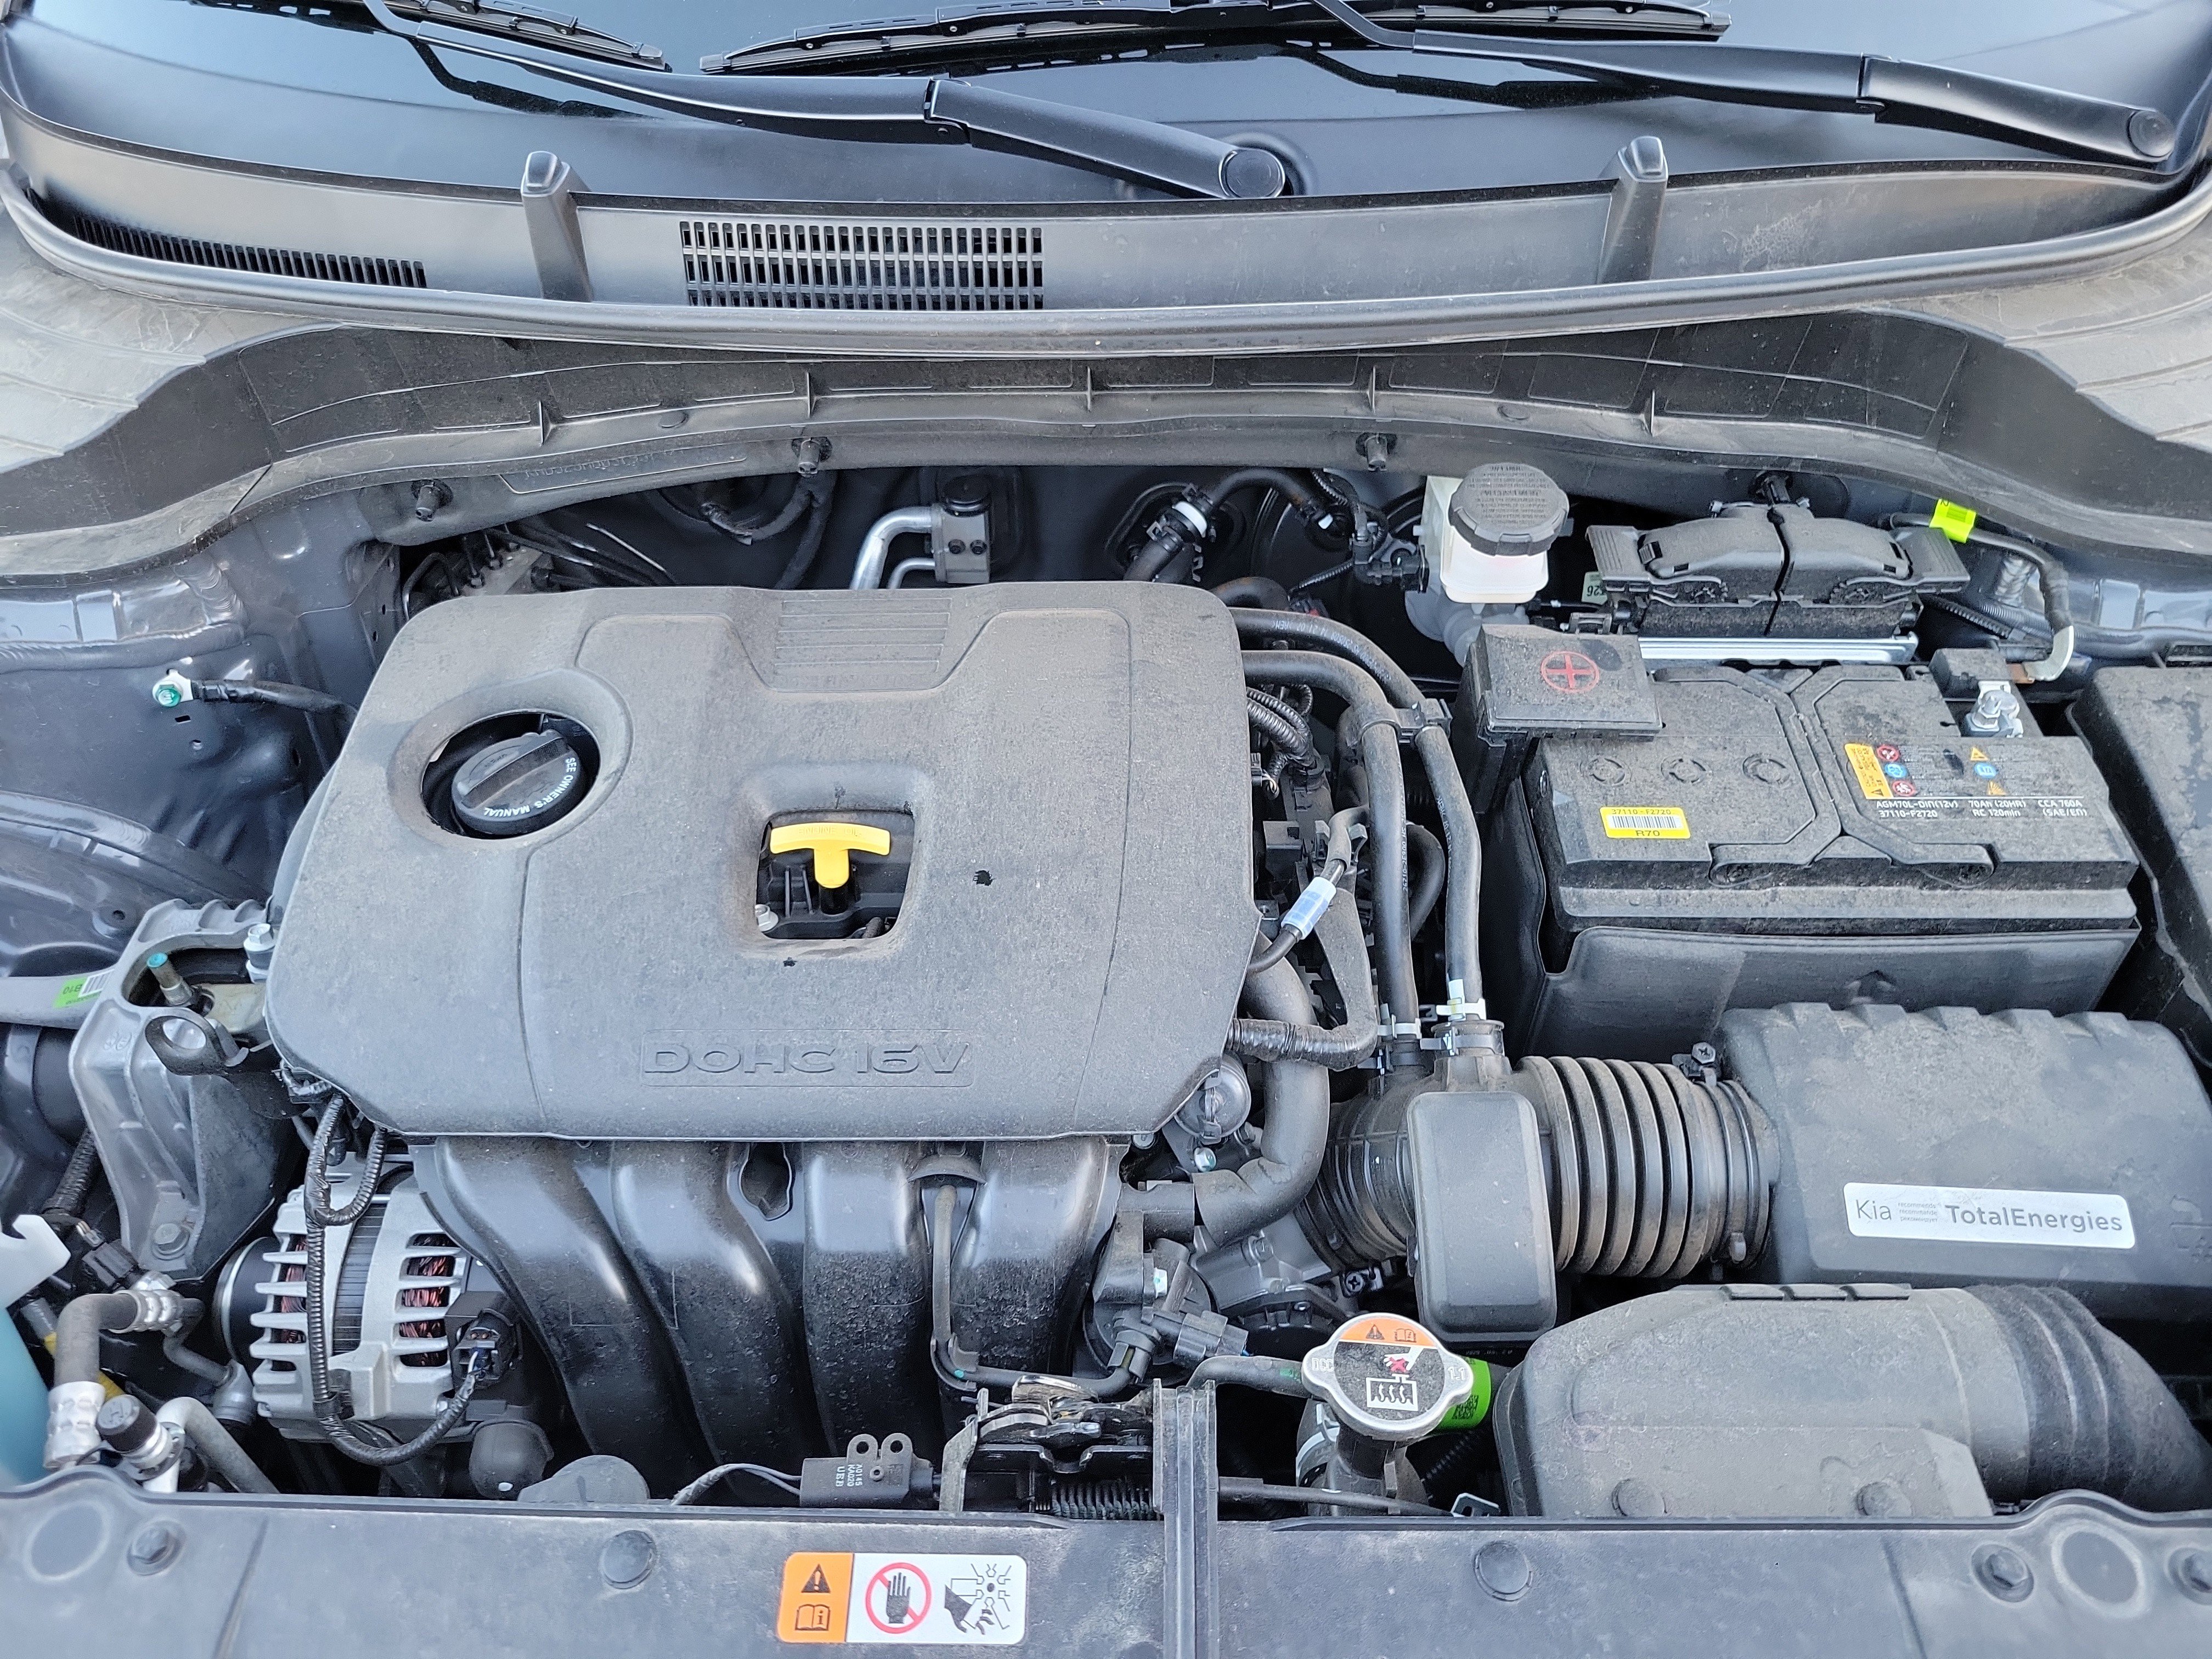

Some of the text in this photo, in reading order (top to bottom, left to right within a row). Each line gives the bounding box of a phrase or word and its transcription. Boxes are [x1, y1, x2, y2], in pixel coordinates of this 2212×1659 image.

[484, 757, 577, 819] SEE OWNER'S MANUAL
[1878, 810, 1938, 818] 37110-F2720
[798, 825, 837, 836] ENGINE
[644, 1042, 969, 1074] DOHC 16V
[1855, 1199, 2123, 1233] Kia TotalEnergies
